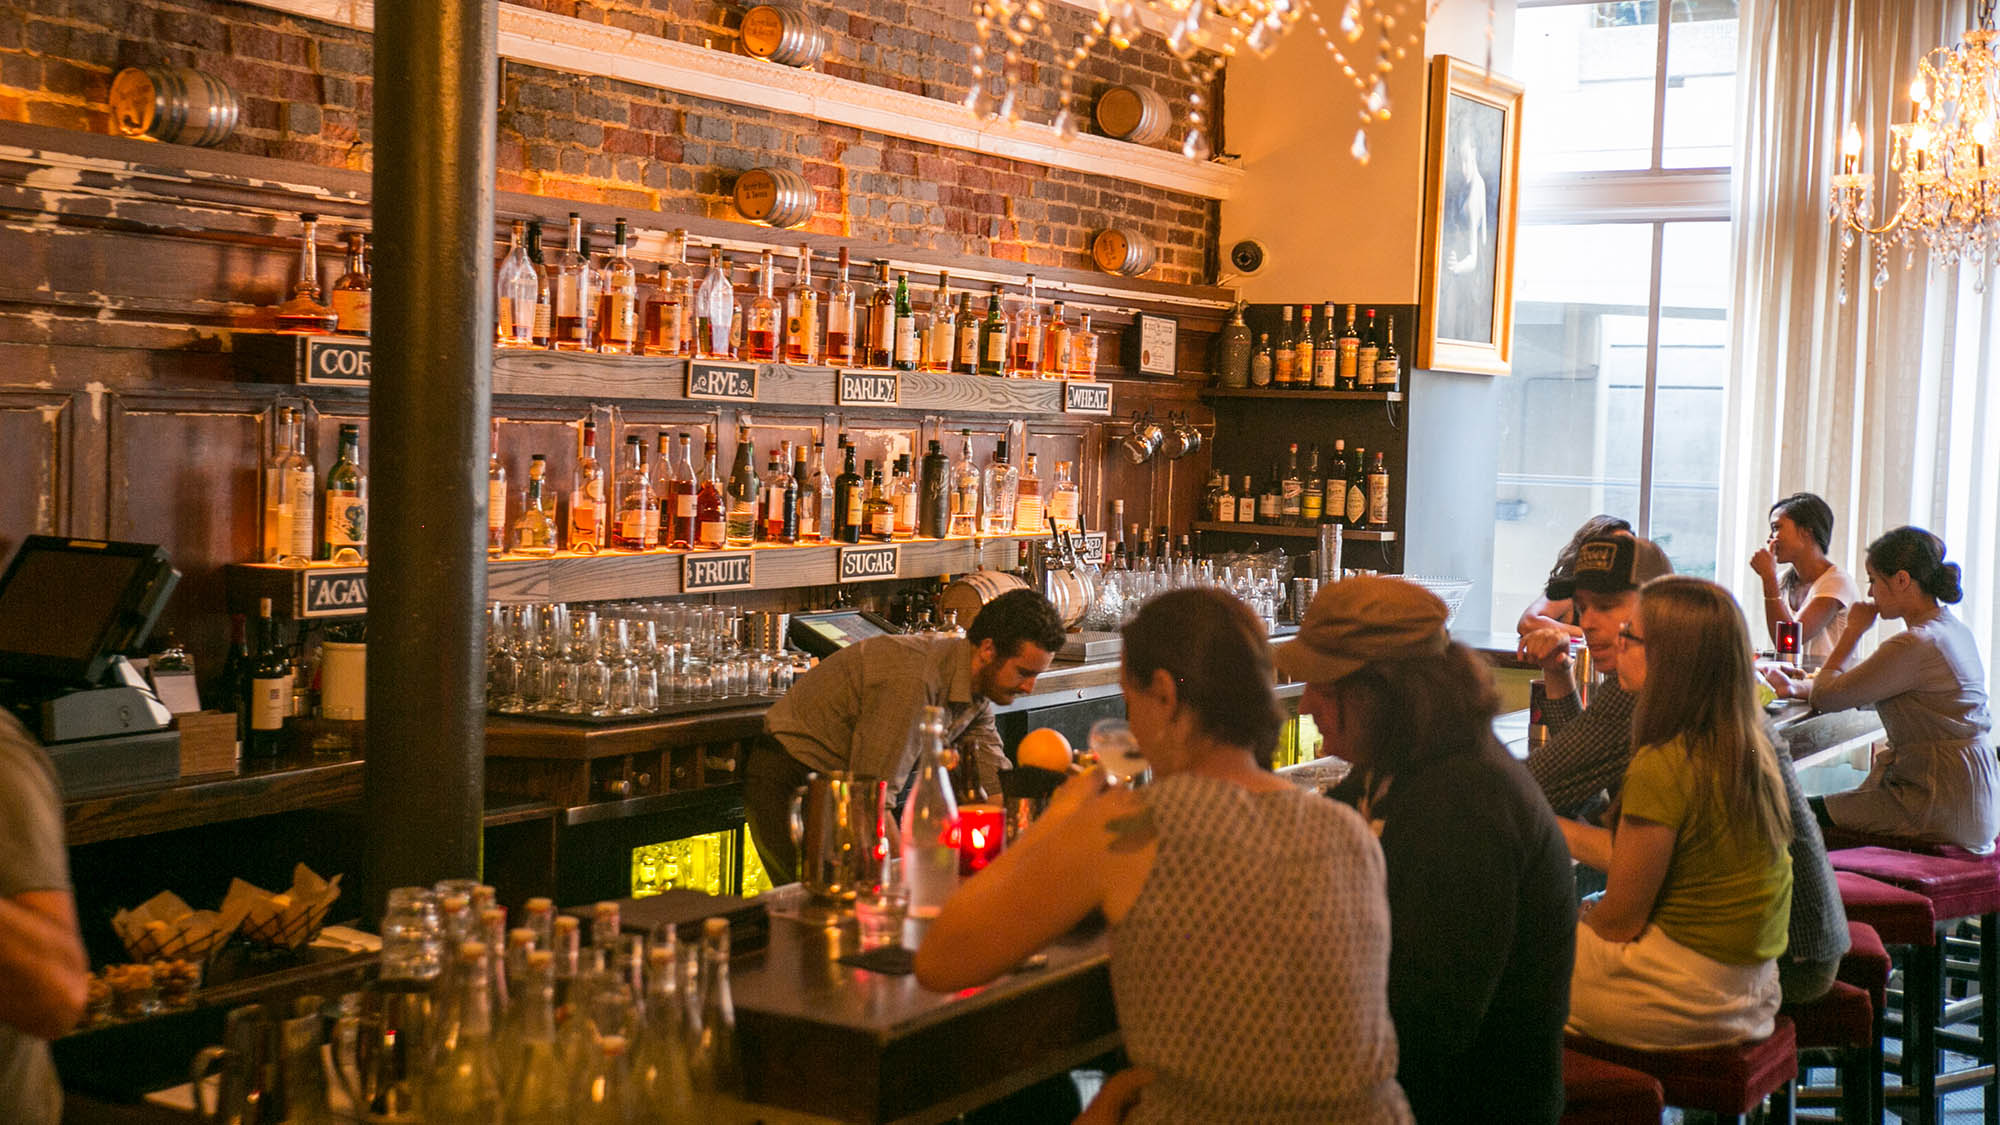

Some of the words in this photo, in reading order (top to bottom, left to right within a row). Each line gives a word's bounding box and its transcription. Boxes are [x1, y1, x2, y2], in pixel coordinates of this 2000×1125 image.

[707, 370, 739, 395] RYE
[843, 377, 896, 402] BARLEY
[1069, 386, 1108, 409] WHEAT
[694, 558, 747, 585] FRUIT
[845, 551, 894, 575] SUGAR
